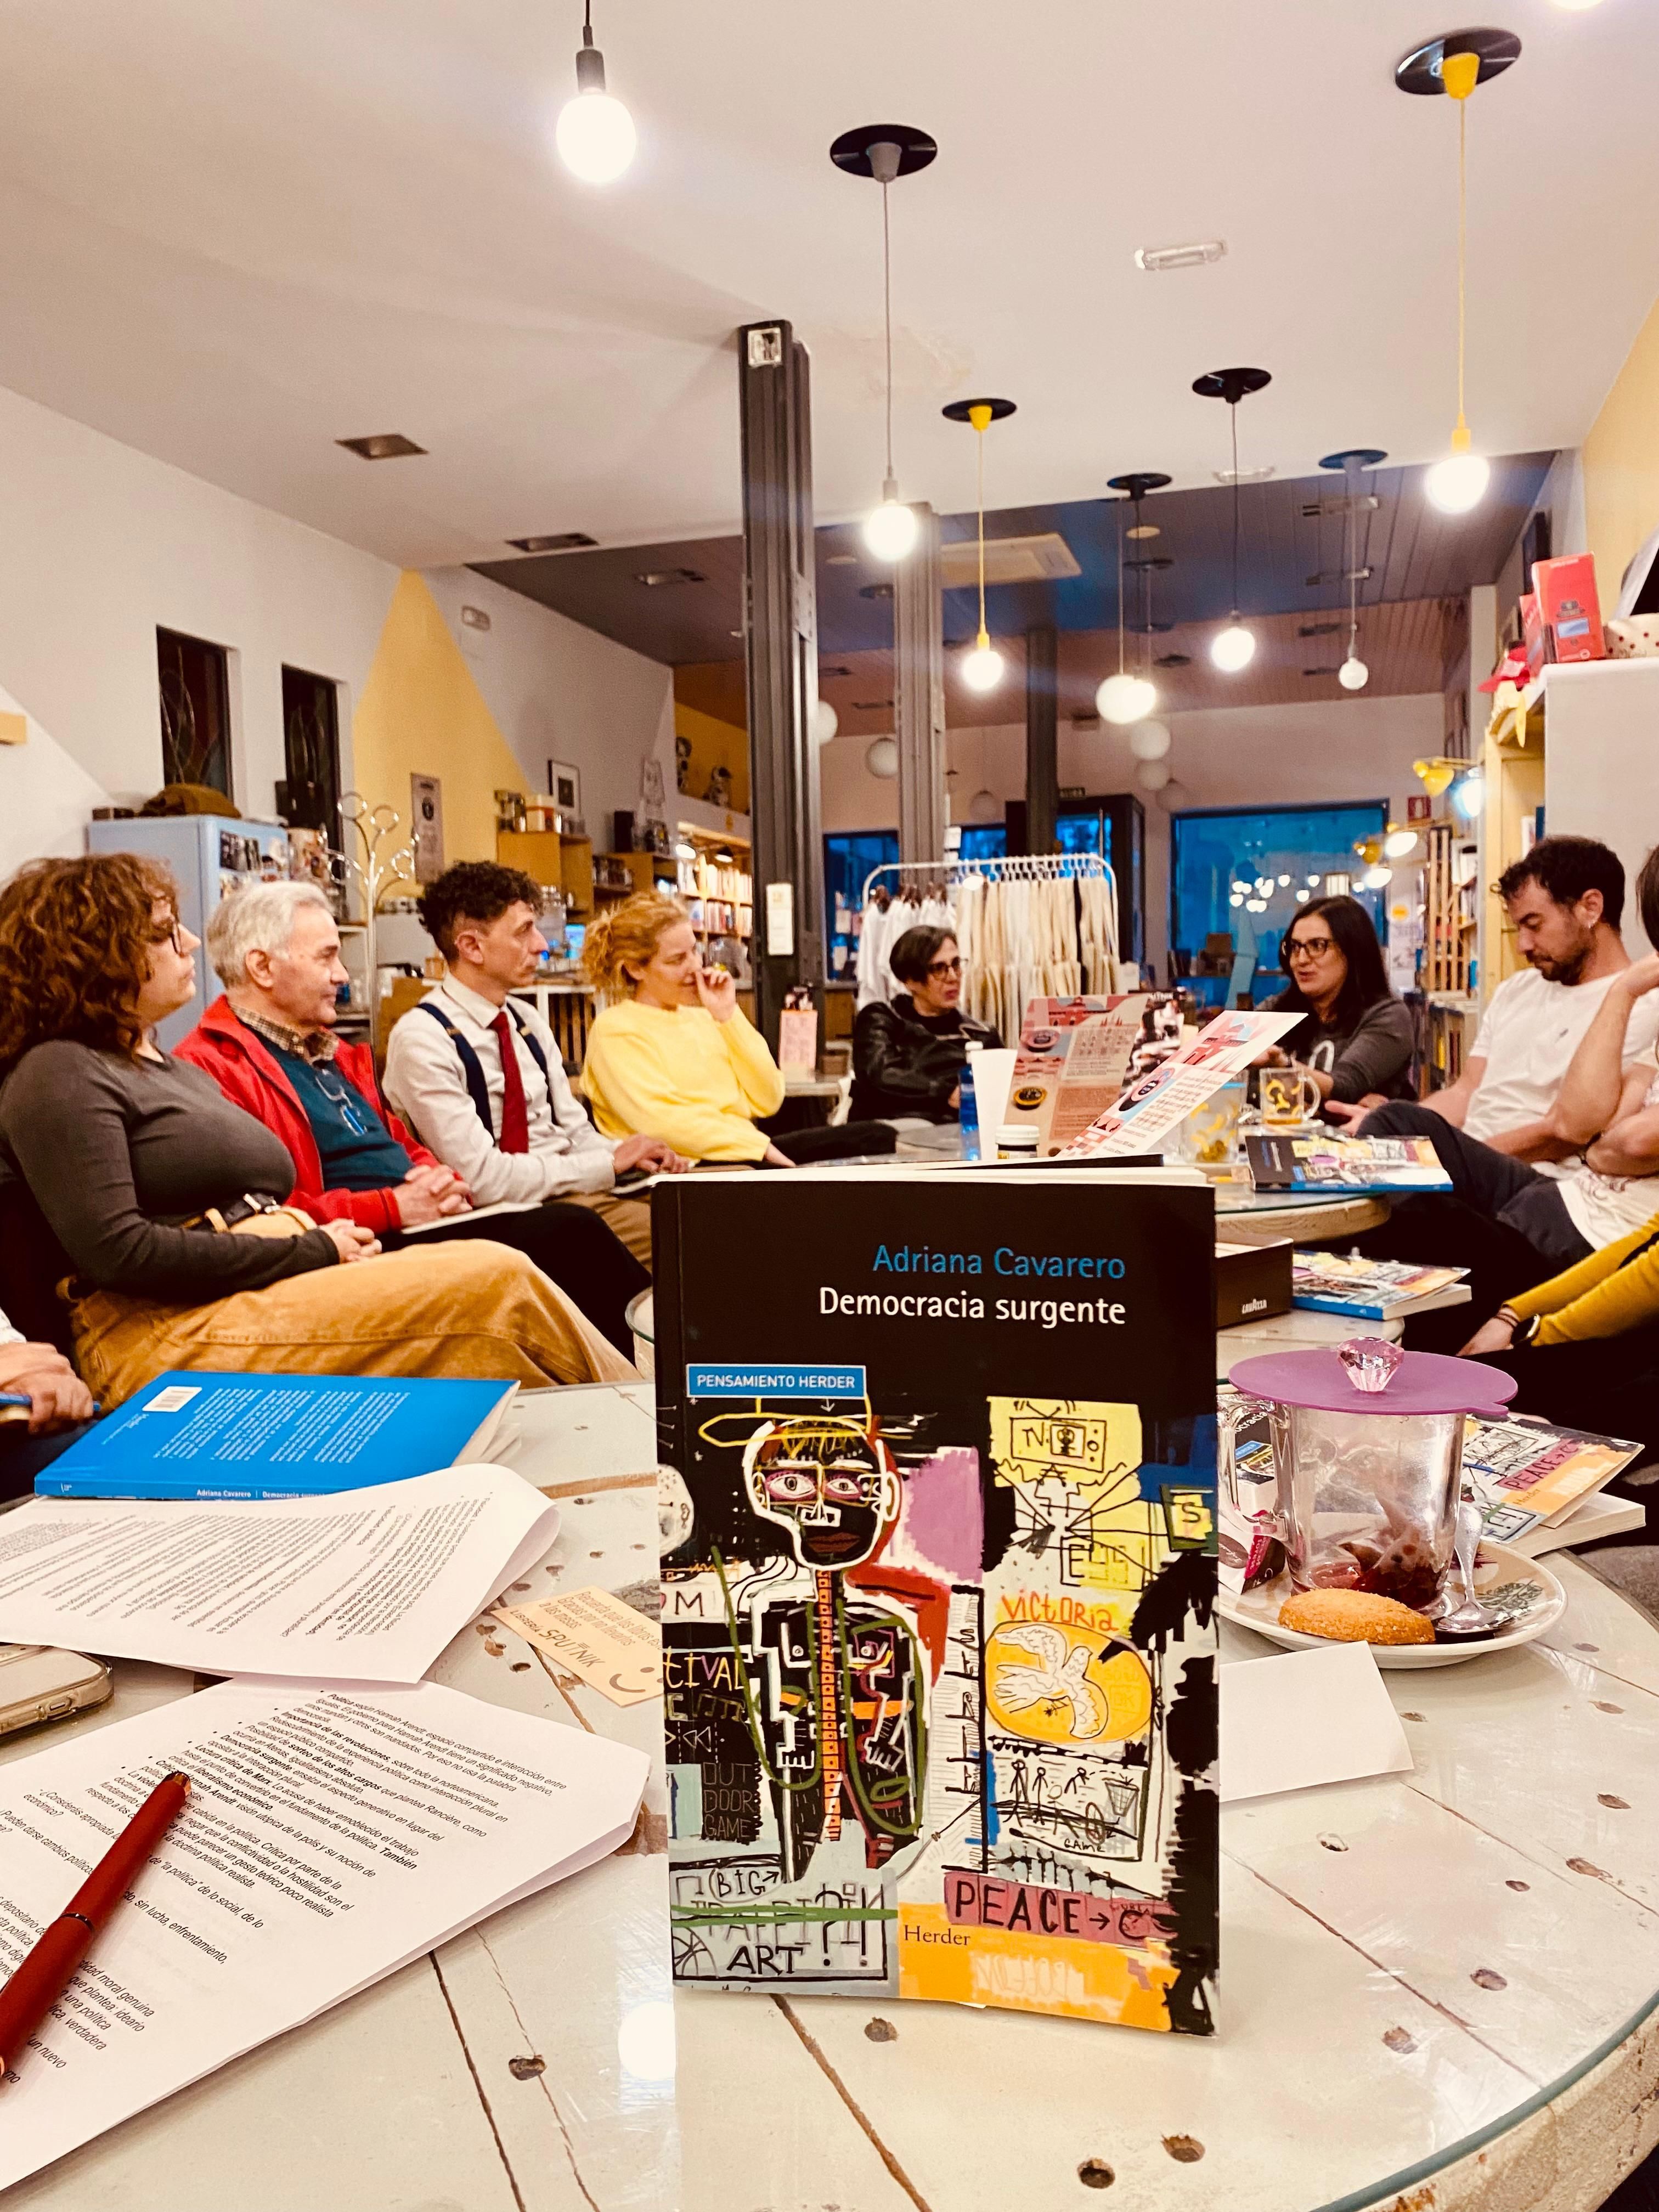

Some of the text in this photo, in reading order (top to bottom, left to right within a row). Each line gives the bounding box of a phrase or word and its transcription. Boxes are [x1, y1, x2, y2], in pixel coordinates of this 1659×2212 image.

[873, 1245, 1126, 1279] Adriana Cavarero
[820, 1286, 1126, 1329] Democracia surgente
[697, 1374, 855, 1389] PENSAMIENTO HERDER
[1504, 1458, 1561, 1489] PEACE
[544, 1605, 561, 1615] las
[554, 1613, 582, 1629] mesas
[557, 1597, 588, 1615] Gracias
[575, 1613, 600, 1622] por
[574, 1591, 612, 1613] Recuerda
[602, 1612, 624, 1622] que
[617, 1617, 634, 1628] los
[628, 1625, 654, 1640] libros
[510, 1610, 606, 1668] LIBRERÍA SPUTNIK
[704, 1789, 756, 1813] DOOR
[80, 1814, 114, 1835] apropiada
[85, 1788, 115, 1804] respecto
[116, 1805, 130, 1814] los
[172, 1839, 202, 1857] doctrina
[196, 1854, 228, 1871] política
[225, 1870, 255, 1888] realista.
[114, 1777, 141, 1792] doctrina
[184, 1818, 208, 1830] negar
[204, 1829, 221, 1837] que
[227, 1839, 278, 1867] conflictividad
[286, 1872, 330, 1897] hostilidad
[324, 1895, 343, 1906] son
[235, 1803, 258, 1815] visión
[255, 1813, 284, 1829] utópica
[297, 1836, 321, 1847] polis
[335, 1855, 364, 1871] noción
[704, 1814, 751, 1839] GAME
[1, 1810, 27, 1829] Pueden
[23, 1827, 44, 1840] darse
[41, 1838, 70, 1858] cambios
[134, 1900, 149, 1910] sin
[100, 1781, 138, 1804] fundamento
[172, 1827, 200, 1841] puede
[194, 1838, 228, 1854] parecer
[232, 1859, 258, 1873] gesto
[255, 1870, 284, 1888] teórico
[279, 1886, 304, 1900] poco
[301, 1899, 334, 1917] realista
[193, 1808, 218, 1822] cabida
[229, 1829, 261, 1846] política.
[261, 1843, 287, 1859] Crítica
[281, 1857, 302, 1865] por
[295, 1864, 321, 1878] parte
[717, 1871, 766, 1897] BIG
[956, 1880, 1080, 1933] PEACE
[904, 1925, 970, 1945] Herder
[0, 1900, 155, 2017] depositario moral genuina
[726, 1945, 803, 1975] ART
[64, 1995, 111, 2030] una política
[66, 1976, 88, 1988] que
[114, 2008, 145, 2032] ideario
[65, 2018, 106, 2050] verdadera
[37, 2047, 67, 2068] nuevo
